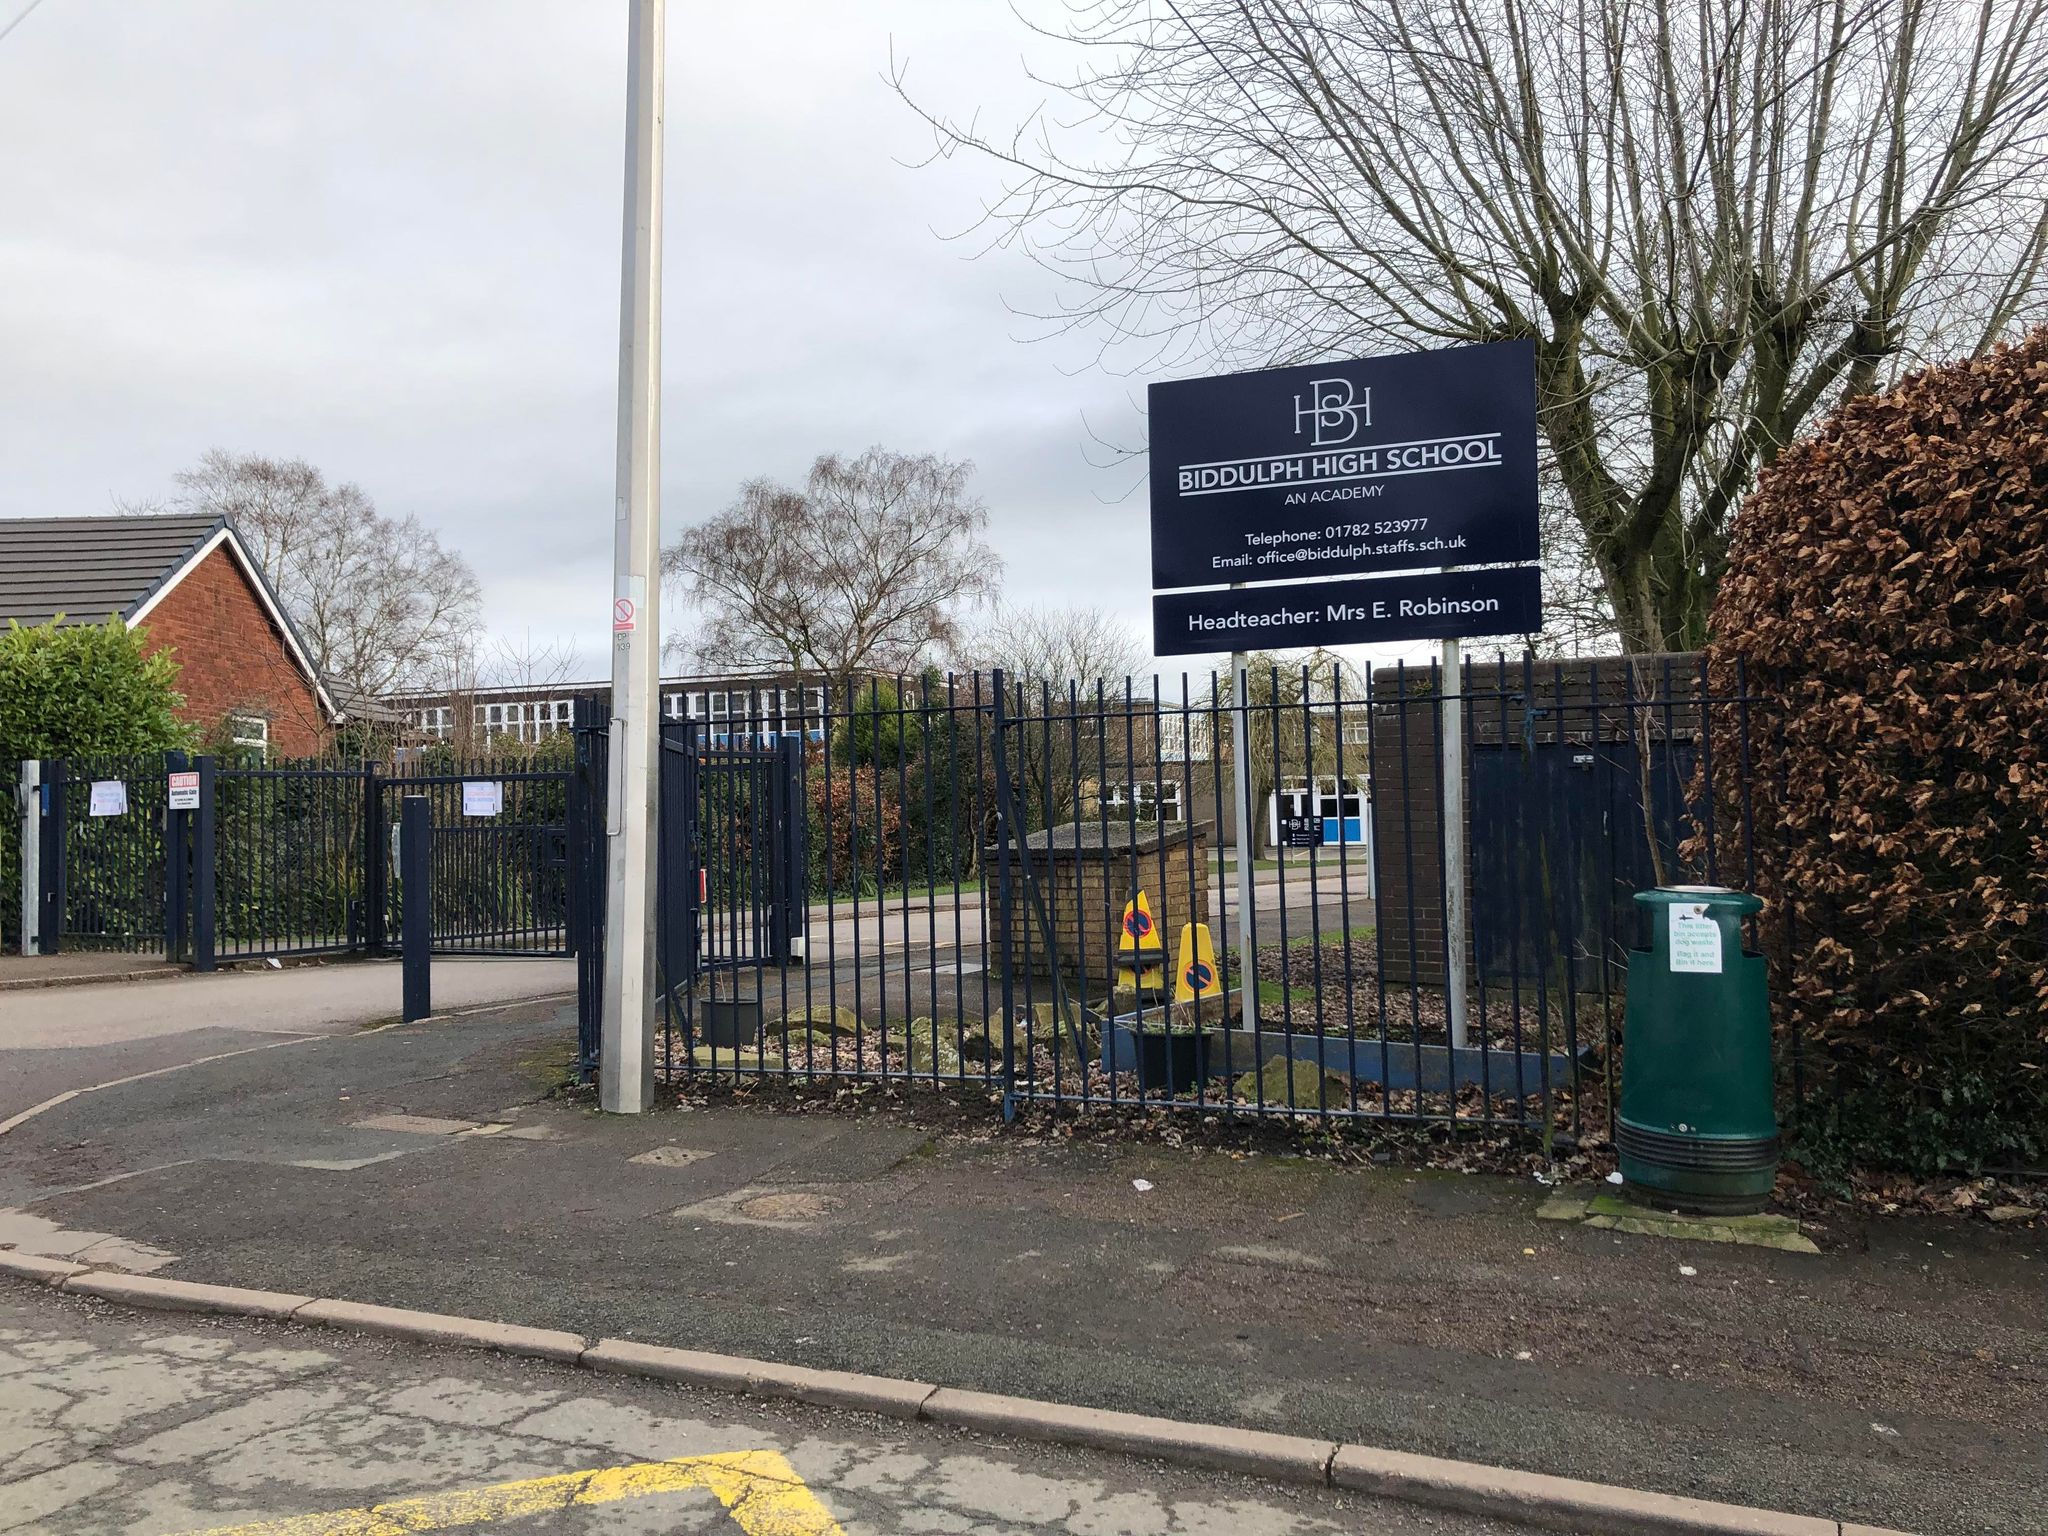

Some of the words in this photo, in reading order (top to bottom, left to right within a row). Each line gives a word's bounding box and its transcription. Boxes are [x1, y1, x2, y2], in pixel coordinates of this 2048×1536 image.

[1178, 458, 1304, 492] BIDDULPH
[1312, 449, 1378, 478] HIGH
[1386, 439, 1503, 470] SCHOOL
[1284, 492, 1307, 506] AN
[1310, 484, 1386, 504] ACADEMY
[1244, 525, 1322, 548] Telephone:
[1325, 522, 1371, 541] 01782
[1373, 517, 1429, 537] 523977
[1211, 553, 1254, 570] Email:
[1256, 535, 1467, 567] office@biddulph.staffs.sch.uk
[1188, 607, 1321, 632] Headteacher:
[1326, 603, 1367, 624] Mrs
[1372, 600, 1393, 619] E.
[1399, 596, 1500, 618] Robinson
[171, 775, 197, 787] CAUTION
